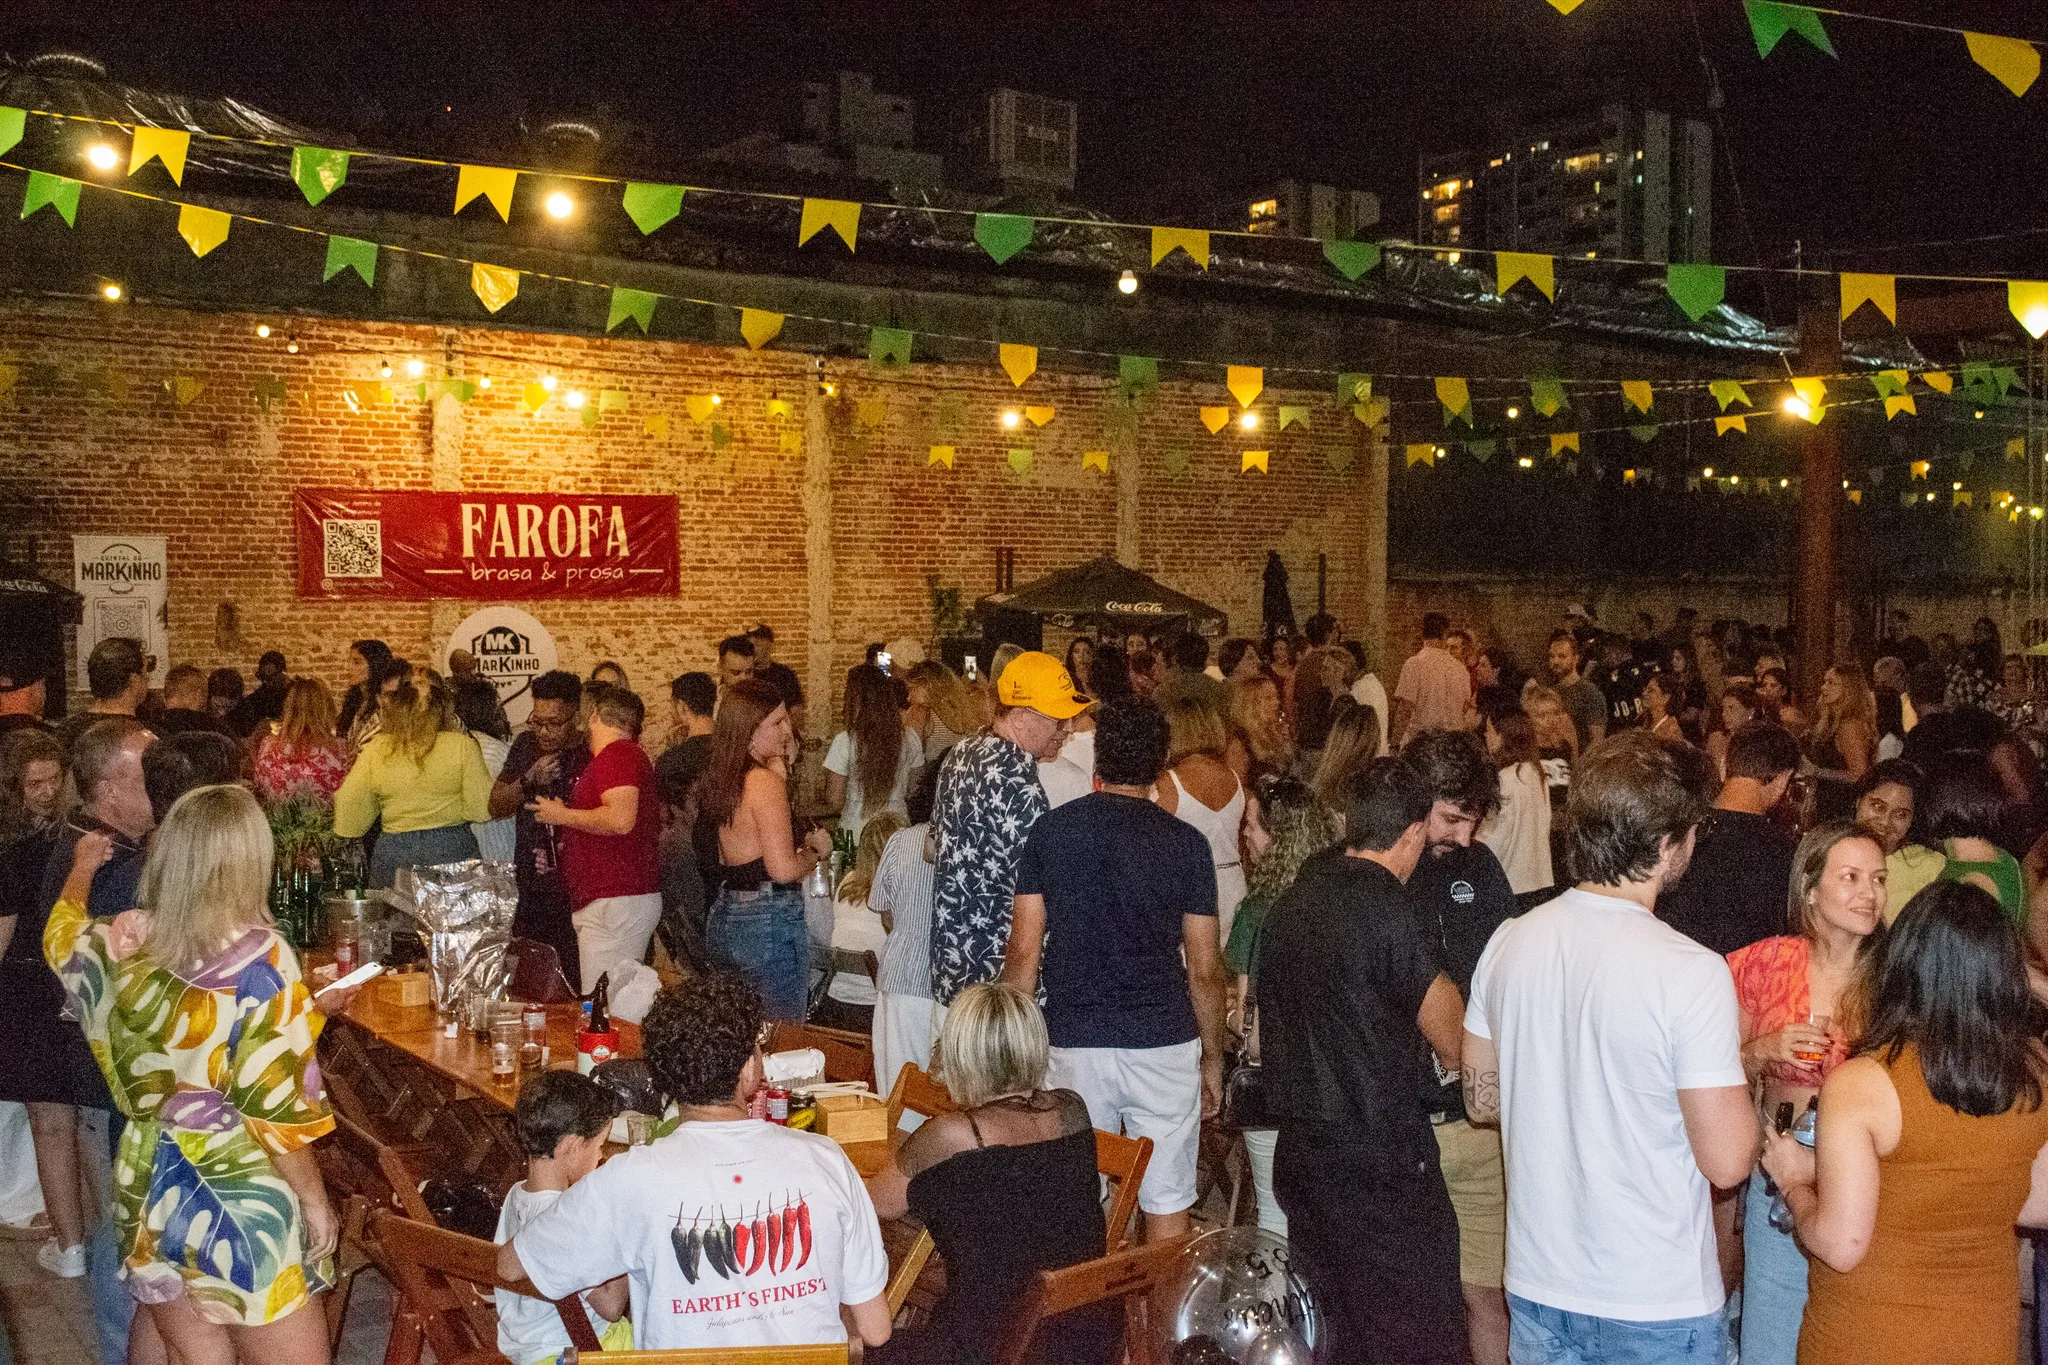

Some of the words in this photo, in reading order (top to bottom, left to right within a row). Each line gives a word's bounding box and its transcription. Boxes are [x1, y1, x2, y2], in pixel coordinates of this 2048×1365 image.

[461, 503, 630, 558] FAROFA
[81, 562, 161, 582] MARKINHO
[471, 562, 532, 581] brasa
[541, 561, 557, 581] &
[566, 566, 624, 588] prosa
[485, 633, 516, 651] MK
[761, 1278, 827, 1305] FINEST
